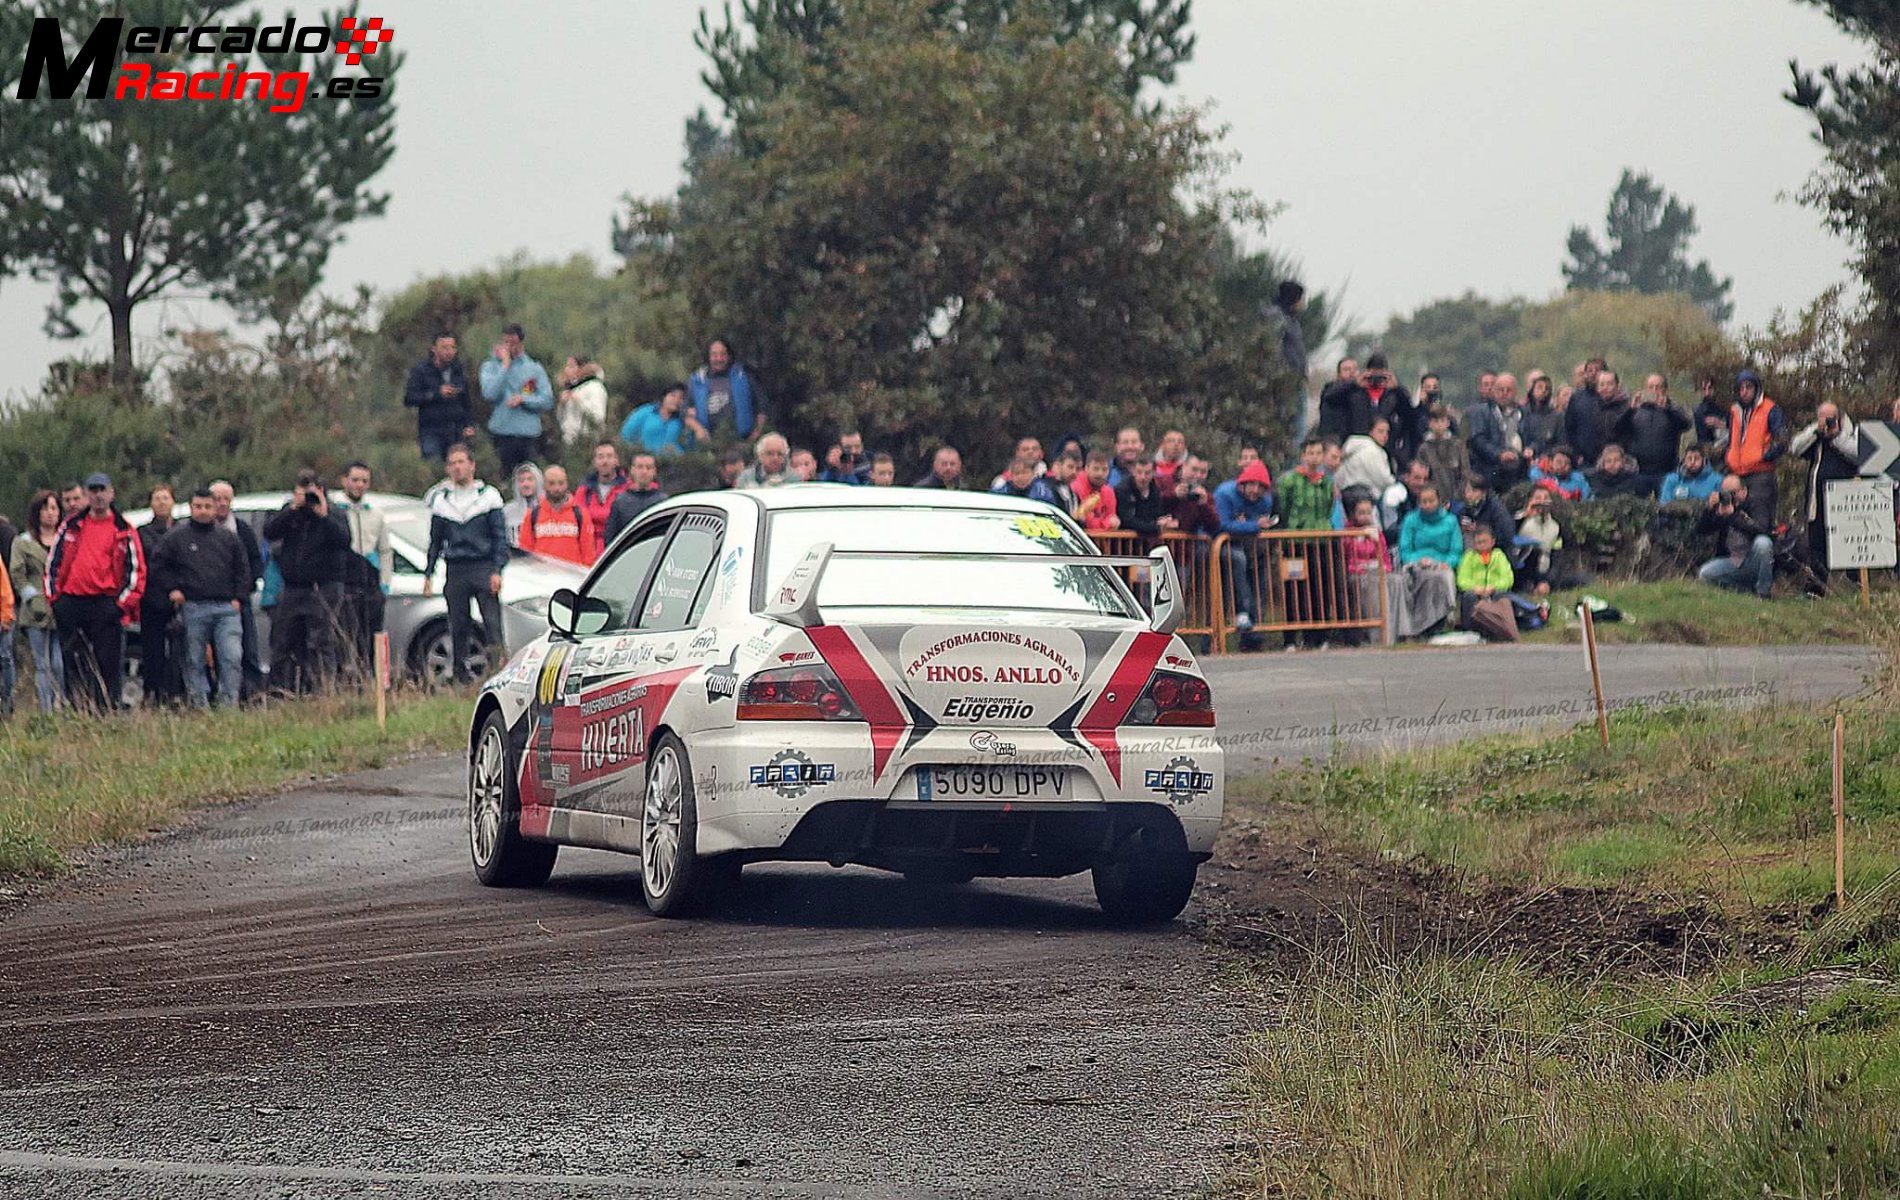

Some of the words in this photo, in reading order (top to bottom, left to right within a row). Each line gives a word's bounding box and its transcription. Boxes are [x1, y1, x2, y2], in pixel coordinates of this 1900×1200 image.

[905, 630, 1022, 678] TRANSFORMACIONES
[1023, 636, 1081, 682] AGRARIAS
[709, 675, 737, 695] TIBOR
[926, 666, 988, 683] HNOS.
[993, 666, 1063, 684] ANLLO
[943, 699, 1034, 722] Eugenio
[963, 696, 1018, 704] TRANSPORTES
[581, 705, 644, 772] HUERTA
[935, 771, 1004, 795] 5090
[1016, 771, 1065, 795] DPV
